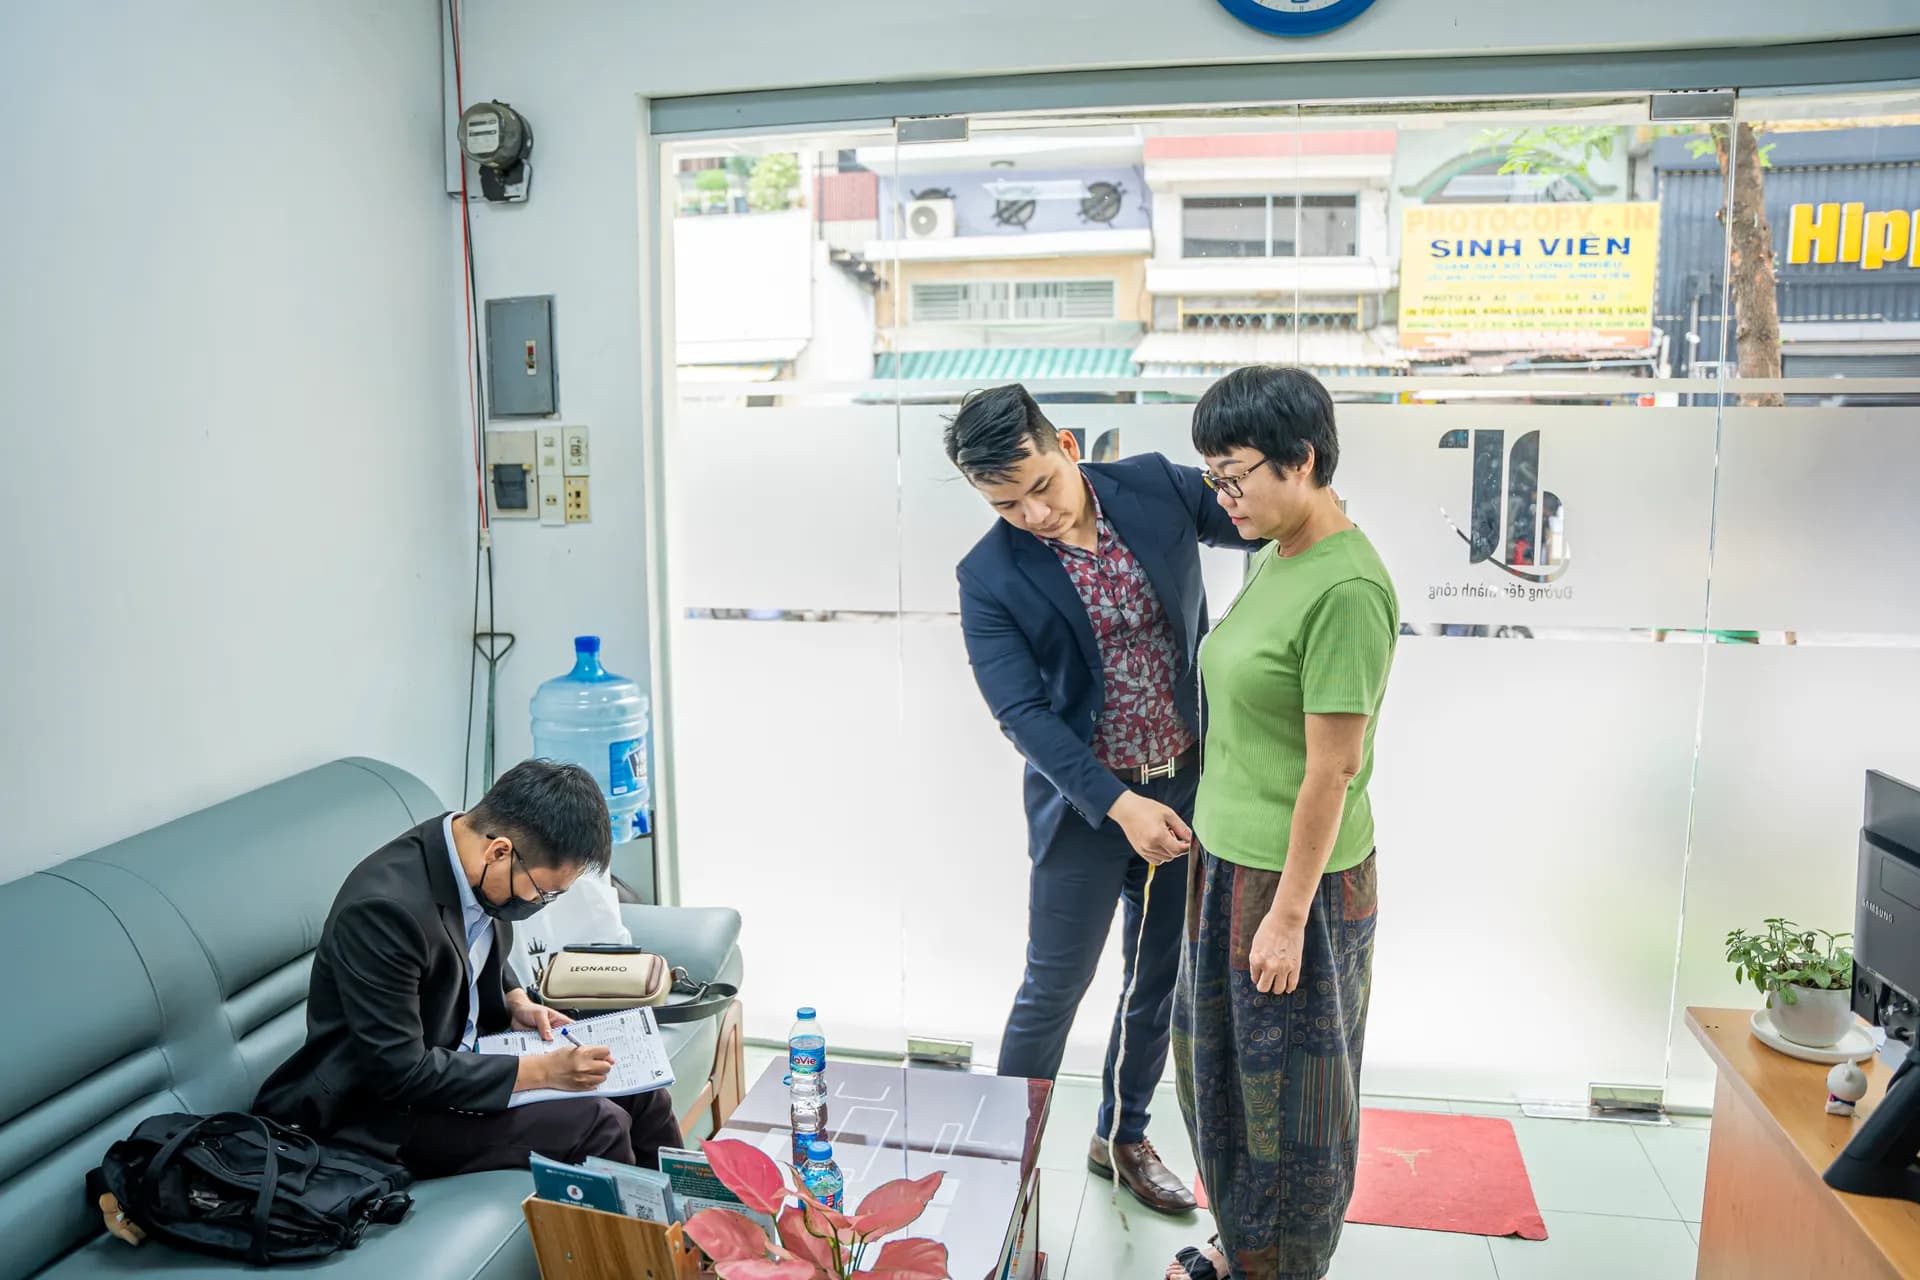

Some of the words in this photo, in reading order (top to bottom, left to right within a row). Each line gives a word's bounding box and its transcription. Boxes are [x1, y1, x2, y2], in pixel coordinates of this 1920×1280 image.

[1407, 207, 1590, 233] PHOTOCOPY
[1623, 206, 1654, 230] IN
[1430, 239, 1522, 258] SINH
[1538, 232, 1631, 256] VIÊN
[1787, 202, 1920, 270] Hip
[1862, 896, 1895, 925] SAMSUNG
[570, 965, 628, 973] LEONARDO
